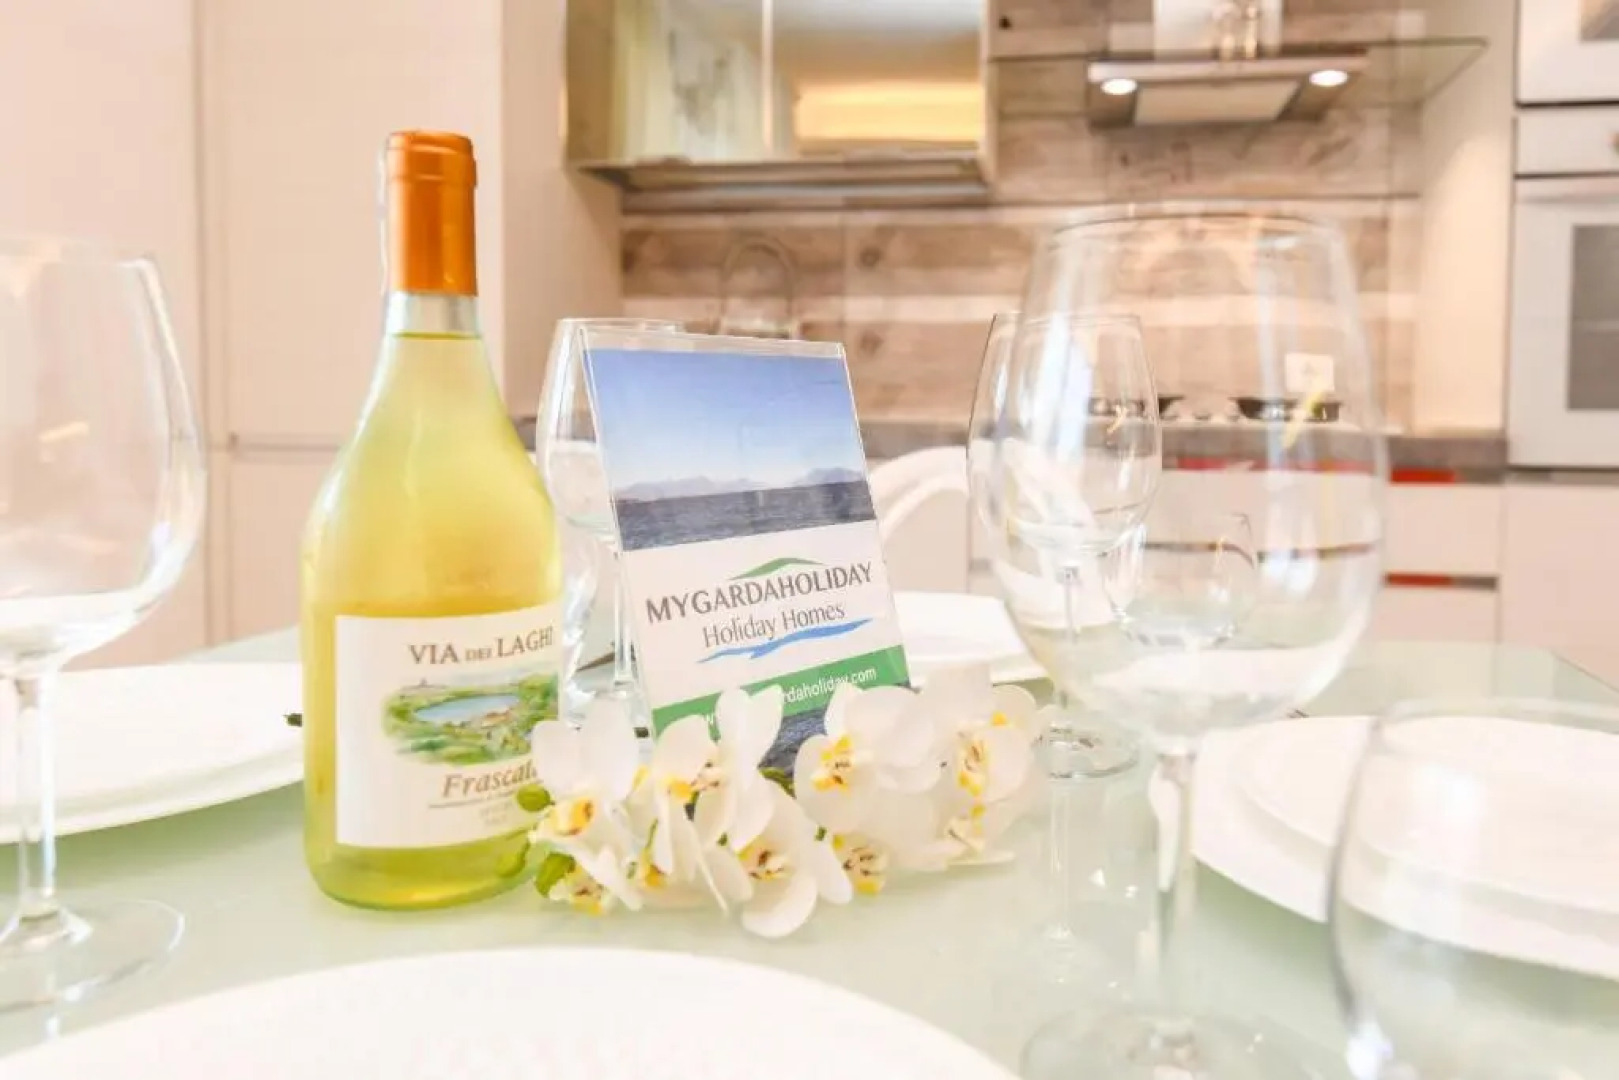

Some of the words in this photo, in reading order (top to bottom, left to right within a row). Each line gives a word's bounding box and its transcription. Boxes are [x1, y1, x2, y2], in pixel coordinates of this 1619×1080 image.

[646, 561, 872, 625] MYGARDAHOLIDAY
[703, 614, 776, 648] Holiday
[781, 602, 845, 631] Homes
[408, 642, 460, 665] VIA
